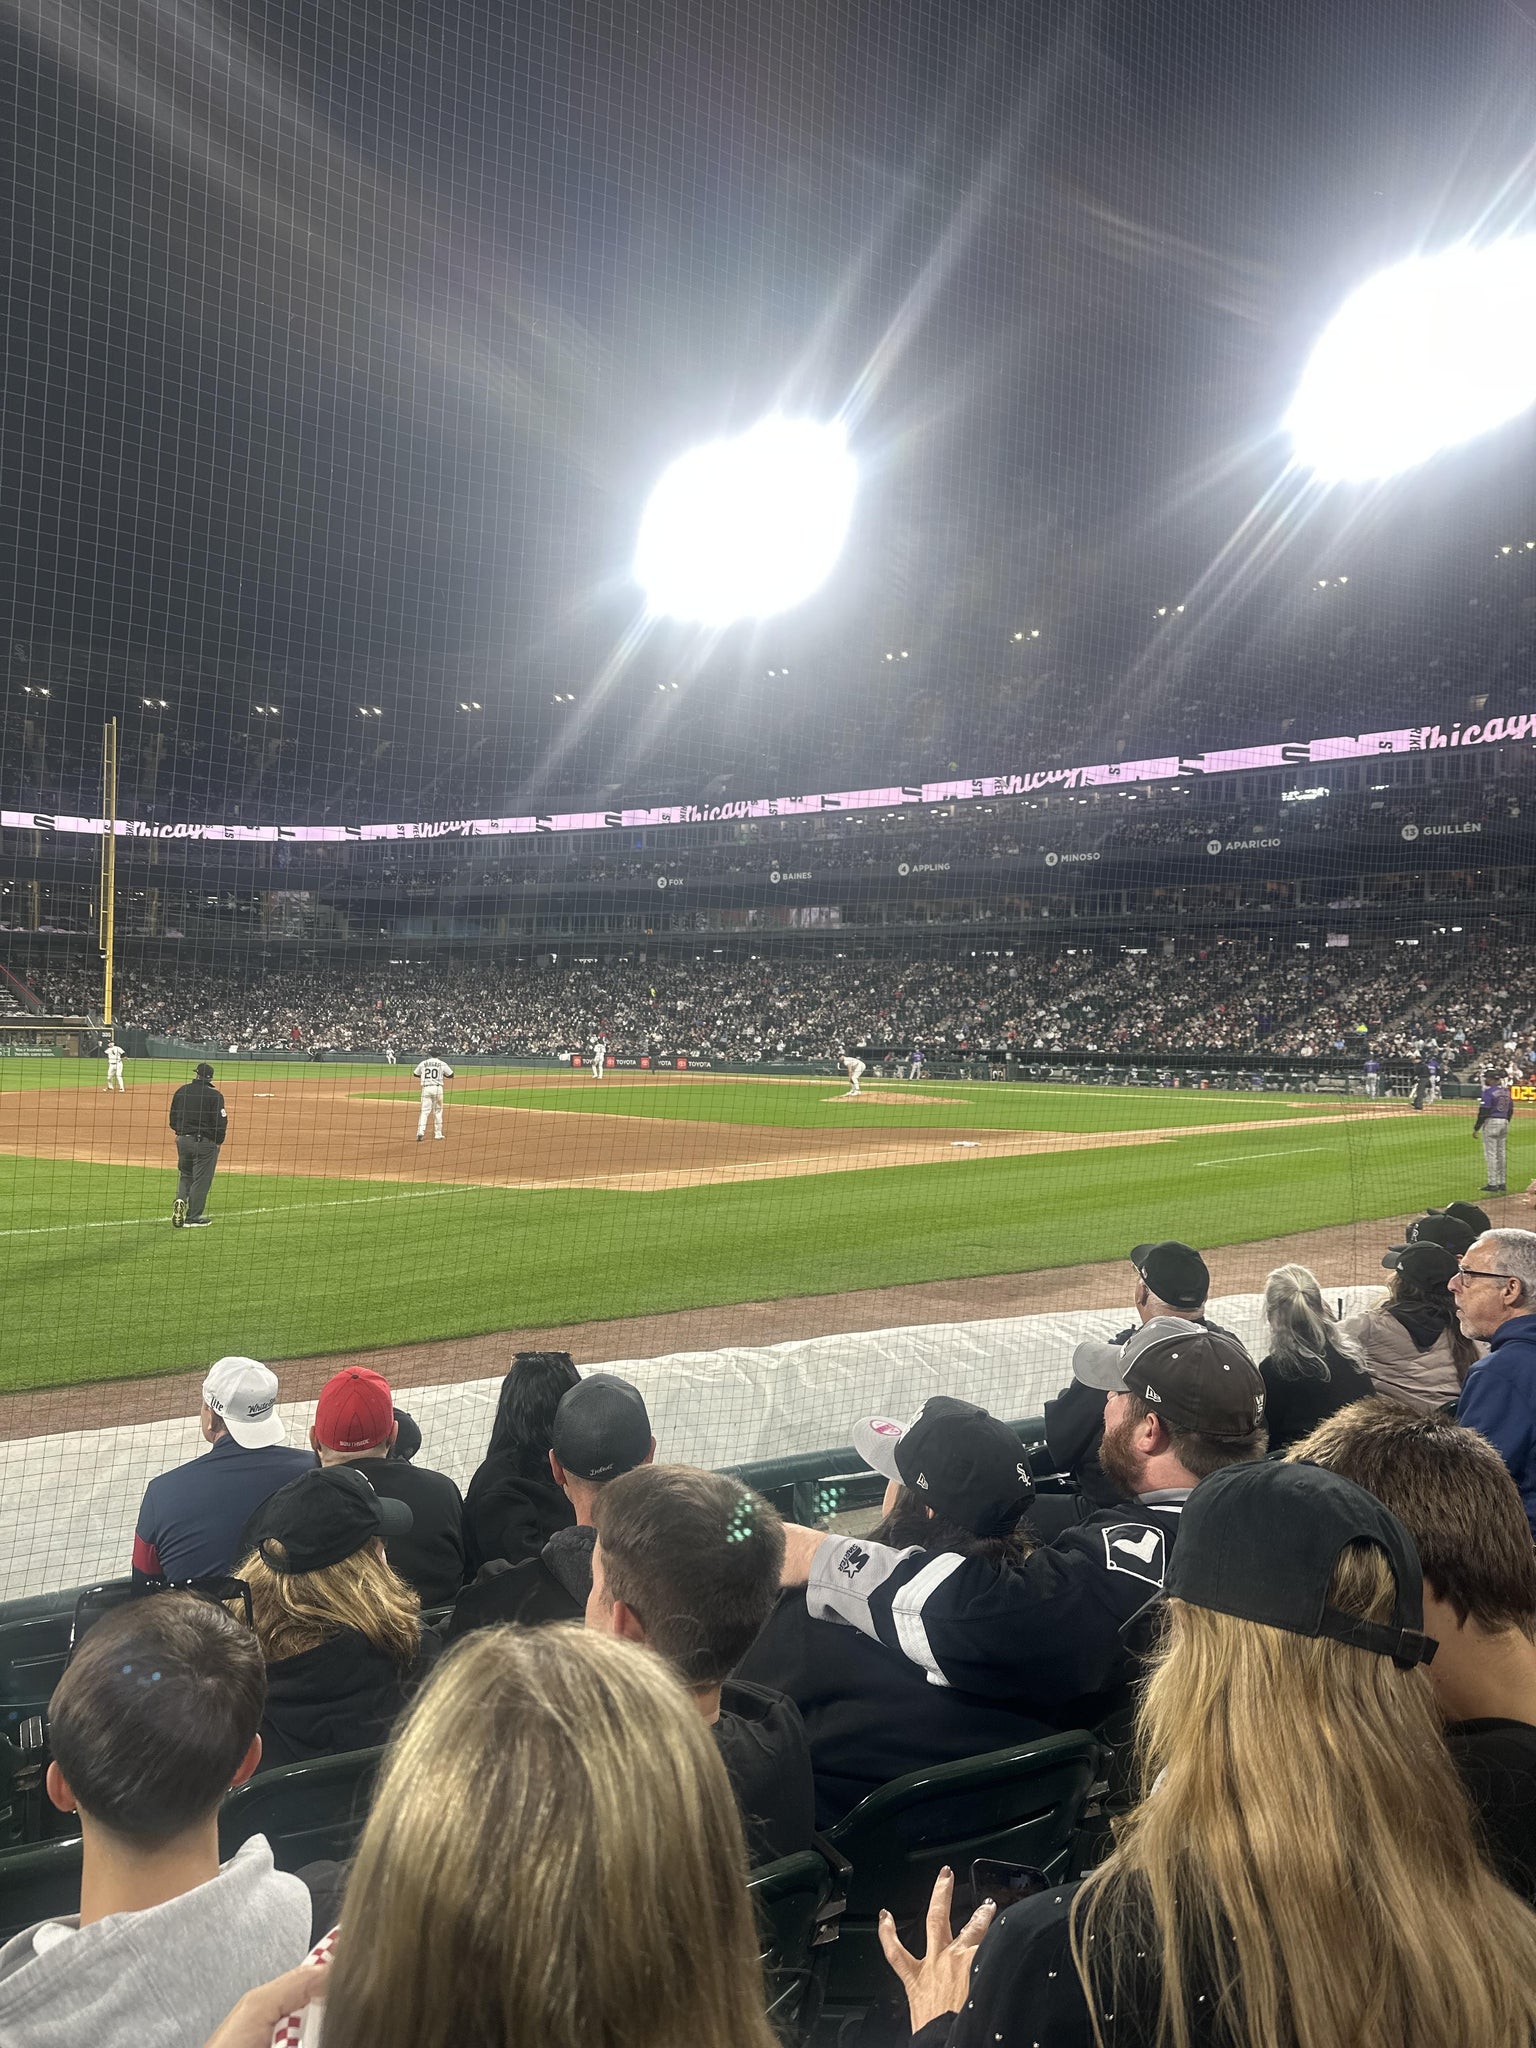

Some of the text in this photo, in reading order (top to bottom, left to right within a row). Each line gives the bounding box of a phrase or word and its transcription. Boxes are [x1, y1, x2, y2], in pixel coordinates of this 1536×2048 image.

[1423, 821, 1481, 836] GUILLÉN
[1225, 838, 1281, 851] APARICIO
[1060, 852, 1101, 863] MINOSO
[912, 862, 950, 873] APPLING
[669, 878, 684, 886] FOX
[783, 872, 813, 881] BAINES
[424, 1068, 438, 1079] 20
